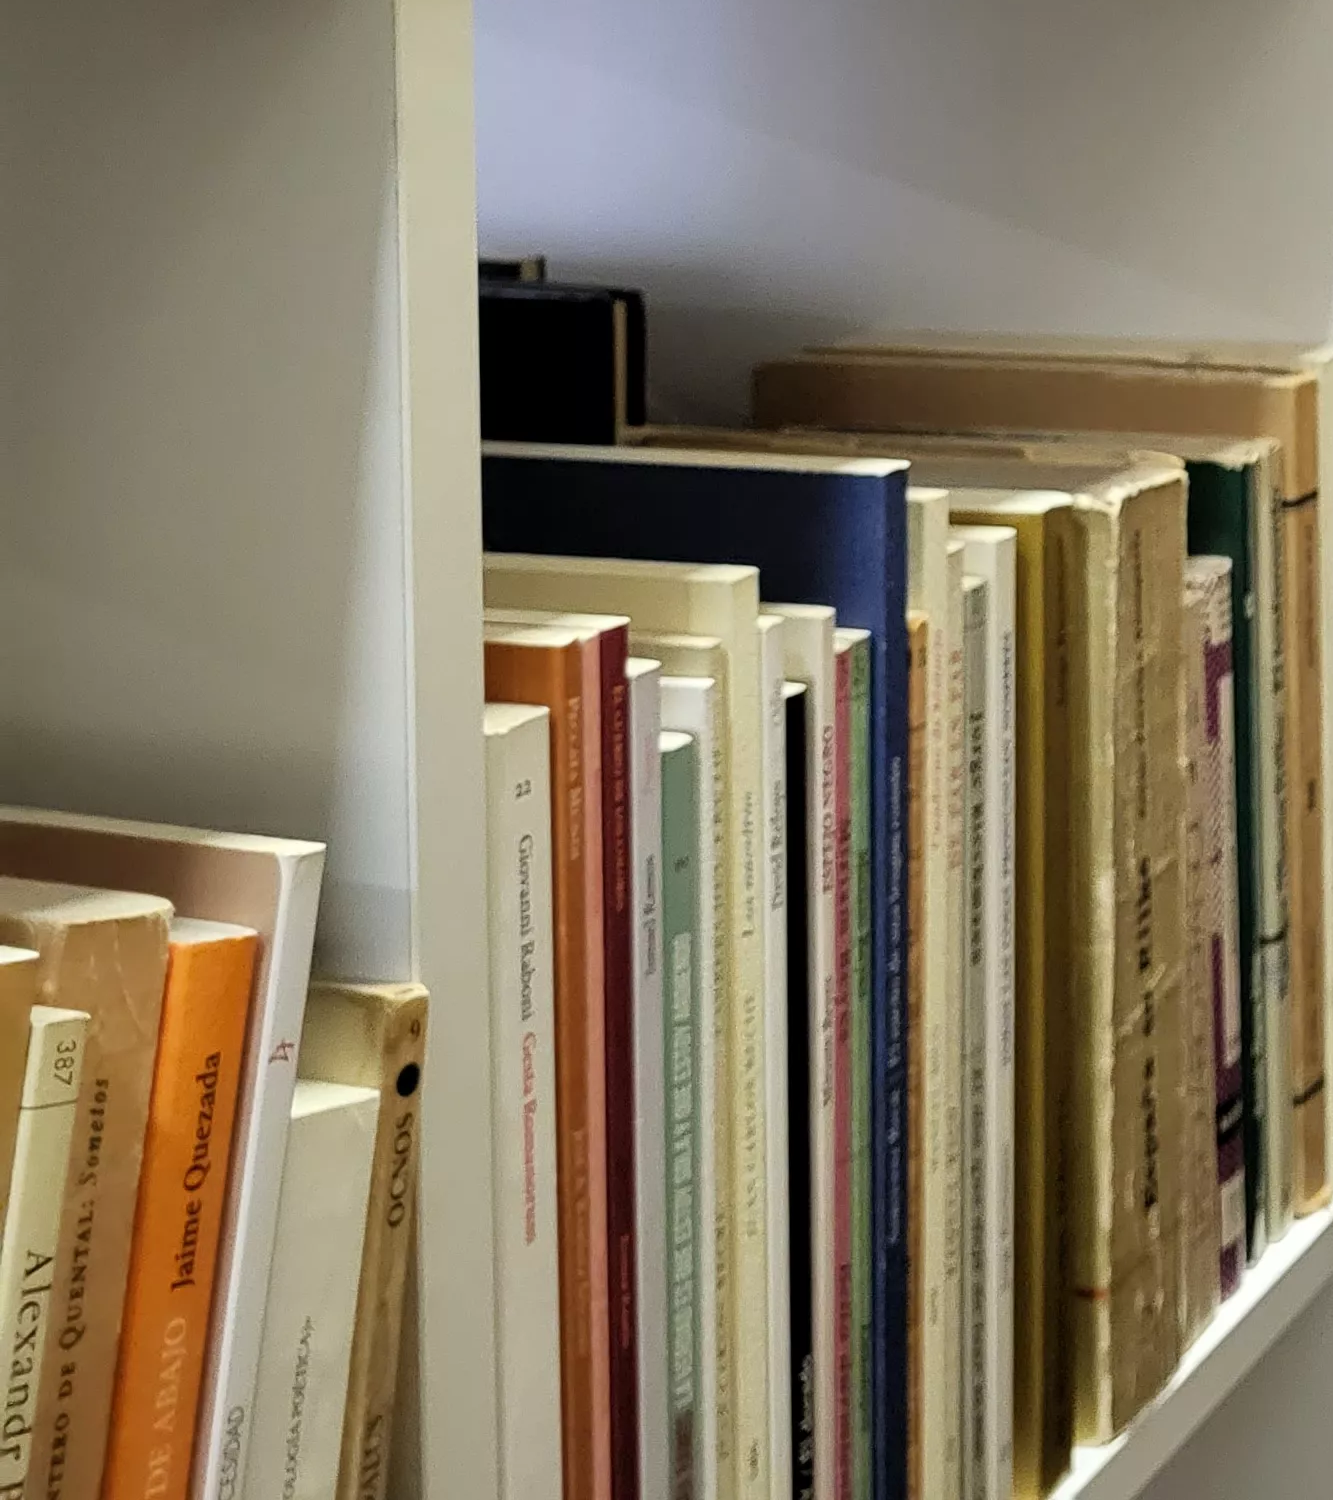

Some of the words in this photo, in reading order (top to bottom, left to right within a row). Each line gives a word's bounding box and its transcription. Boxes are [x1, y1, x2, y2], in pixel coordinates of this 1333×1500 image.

[518, 832, 534, 937] Giovanni
[519, 942, 535, 1021] Raboni
[53, 1039, 77, 1086] 387
[522, 1032, 537, 1095] Gesta
[78, 1077, 110, 1187] Sonetos
[182, 1050, 221, 1193] Quezada
[386, 1112, 414, 1229] OCNOS
[58, 1196, 96, 1351] QUENTAL:
[170, 1198, 203, 1292] Jaime
[58, 1362, 76, 1399] DE
[150, 1315, 187, 1434] ABAJO
[145, 1448, 170, 1499] DE
